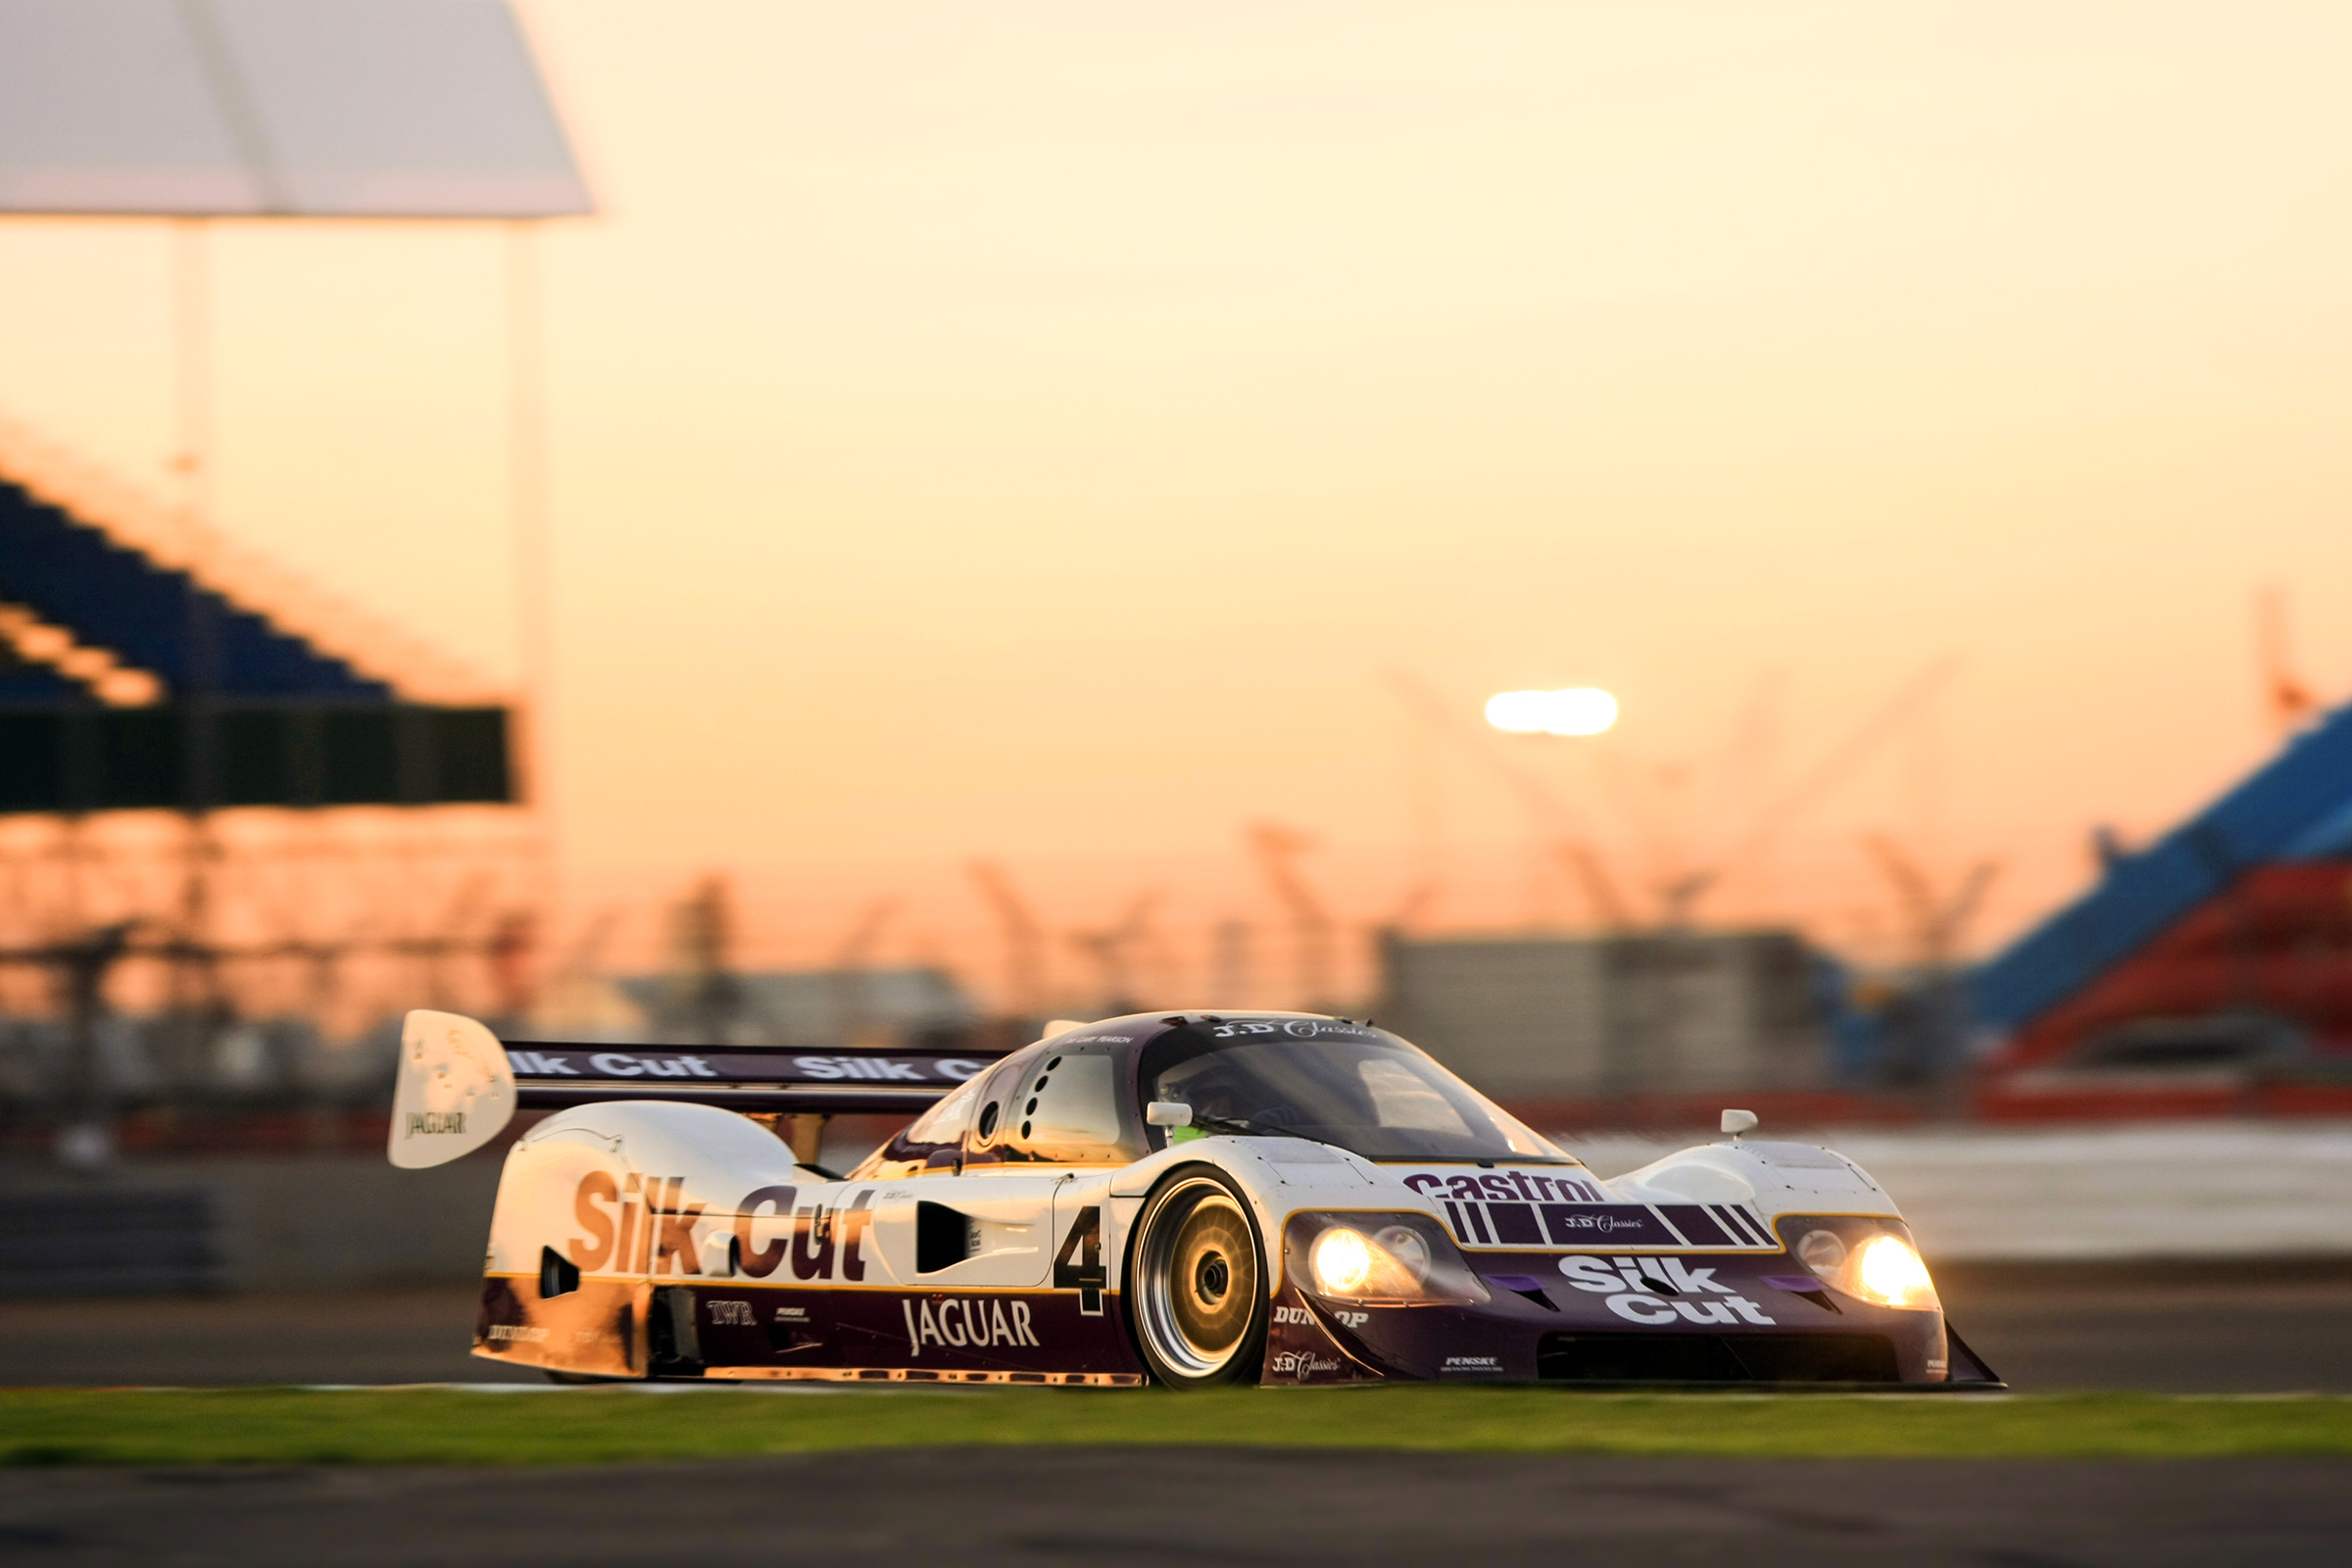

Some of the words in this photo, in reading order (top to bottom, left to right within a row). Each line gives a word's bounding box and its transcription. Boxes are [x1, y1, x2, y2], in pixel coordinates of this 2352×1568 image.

[507, 1051, 580, 1075] lk
[589, 1053, 717, 1077] Cut
[792, 1056, 927, 1080] Silk
[405, 1111, 466, 1140] JAGUAR
[567, 1170, 708, 1275] Silk
[733, 1185, 876, 1281] Cut
[1054, 1205, 1107, 1316] 4
[1558, 1255, 1738, 1294] Silk
[707, 1300, 758, 1326] TWR
[1274, 1306, 1369, 1328] DUNOP
[1605, 1294, 1777, 1325] Cut
[903, 1298, 1040, 1357] JAGUAR
[1446, 1356, 1498, 1366] PENSKE
